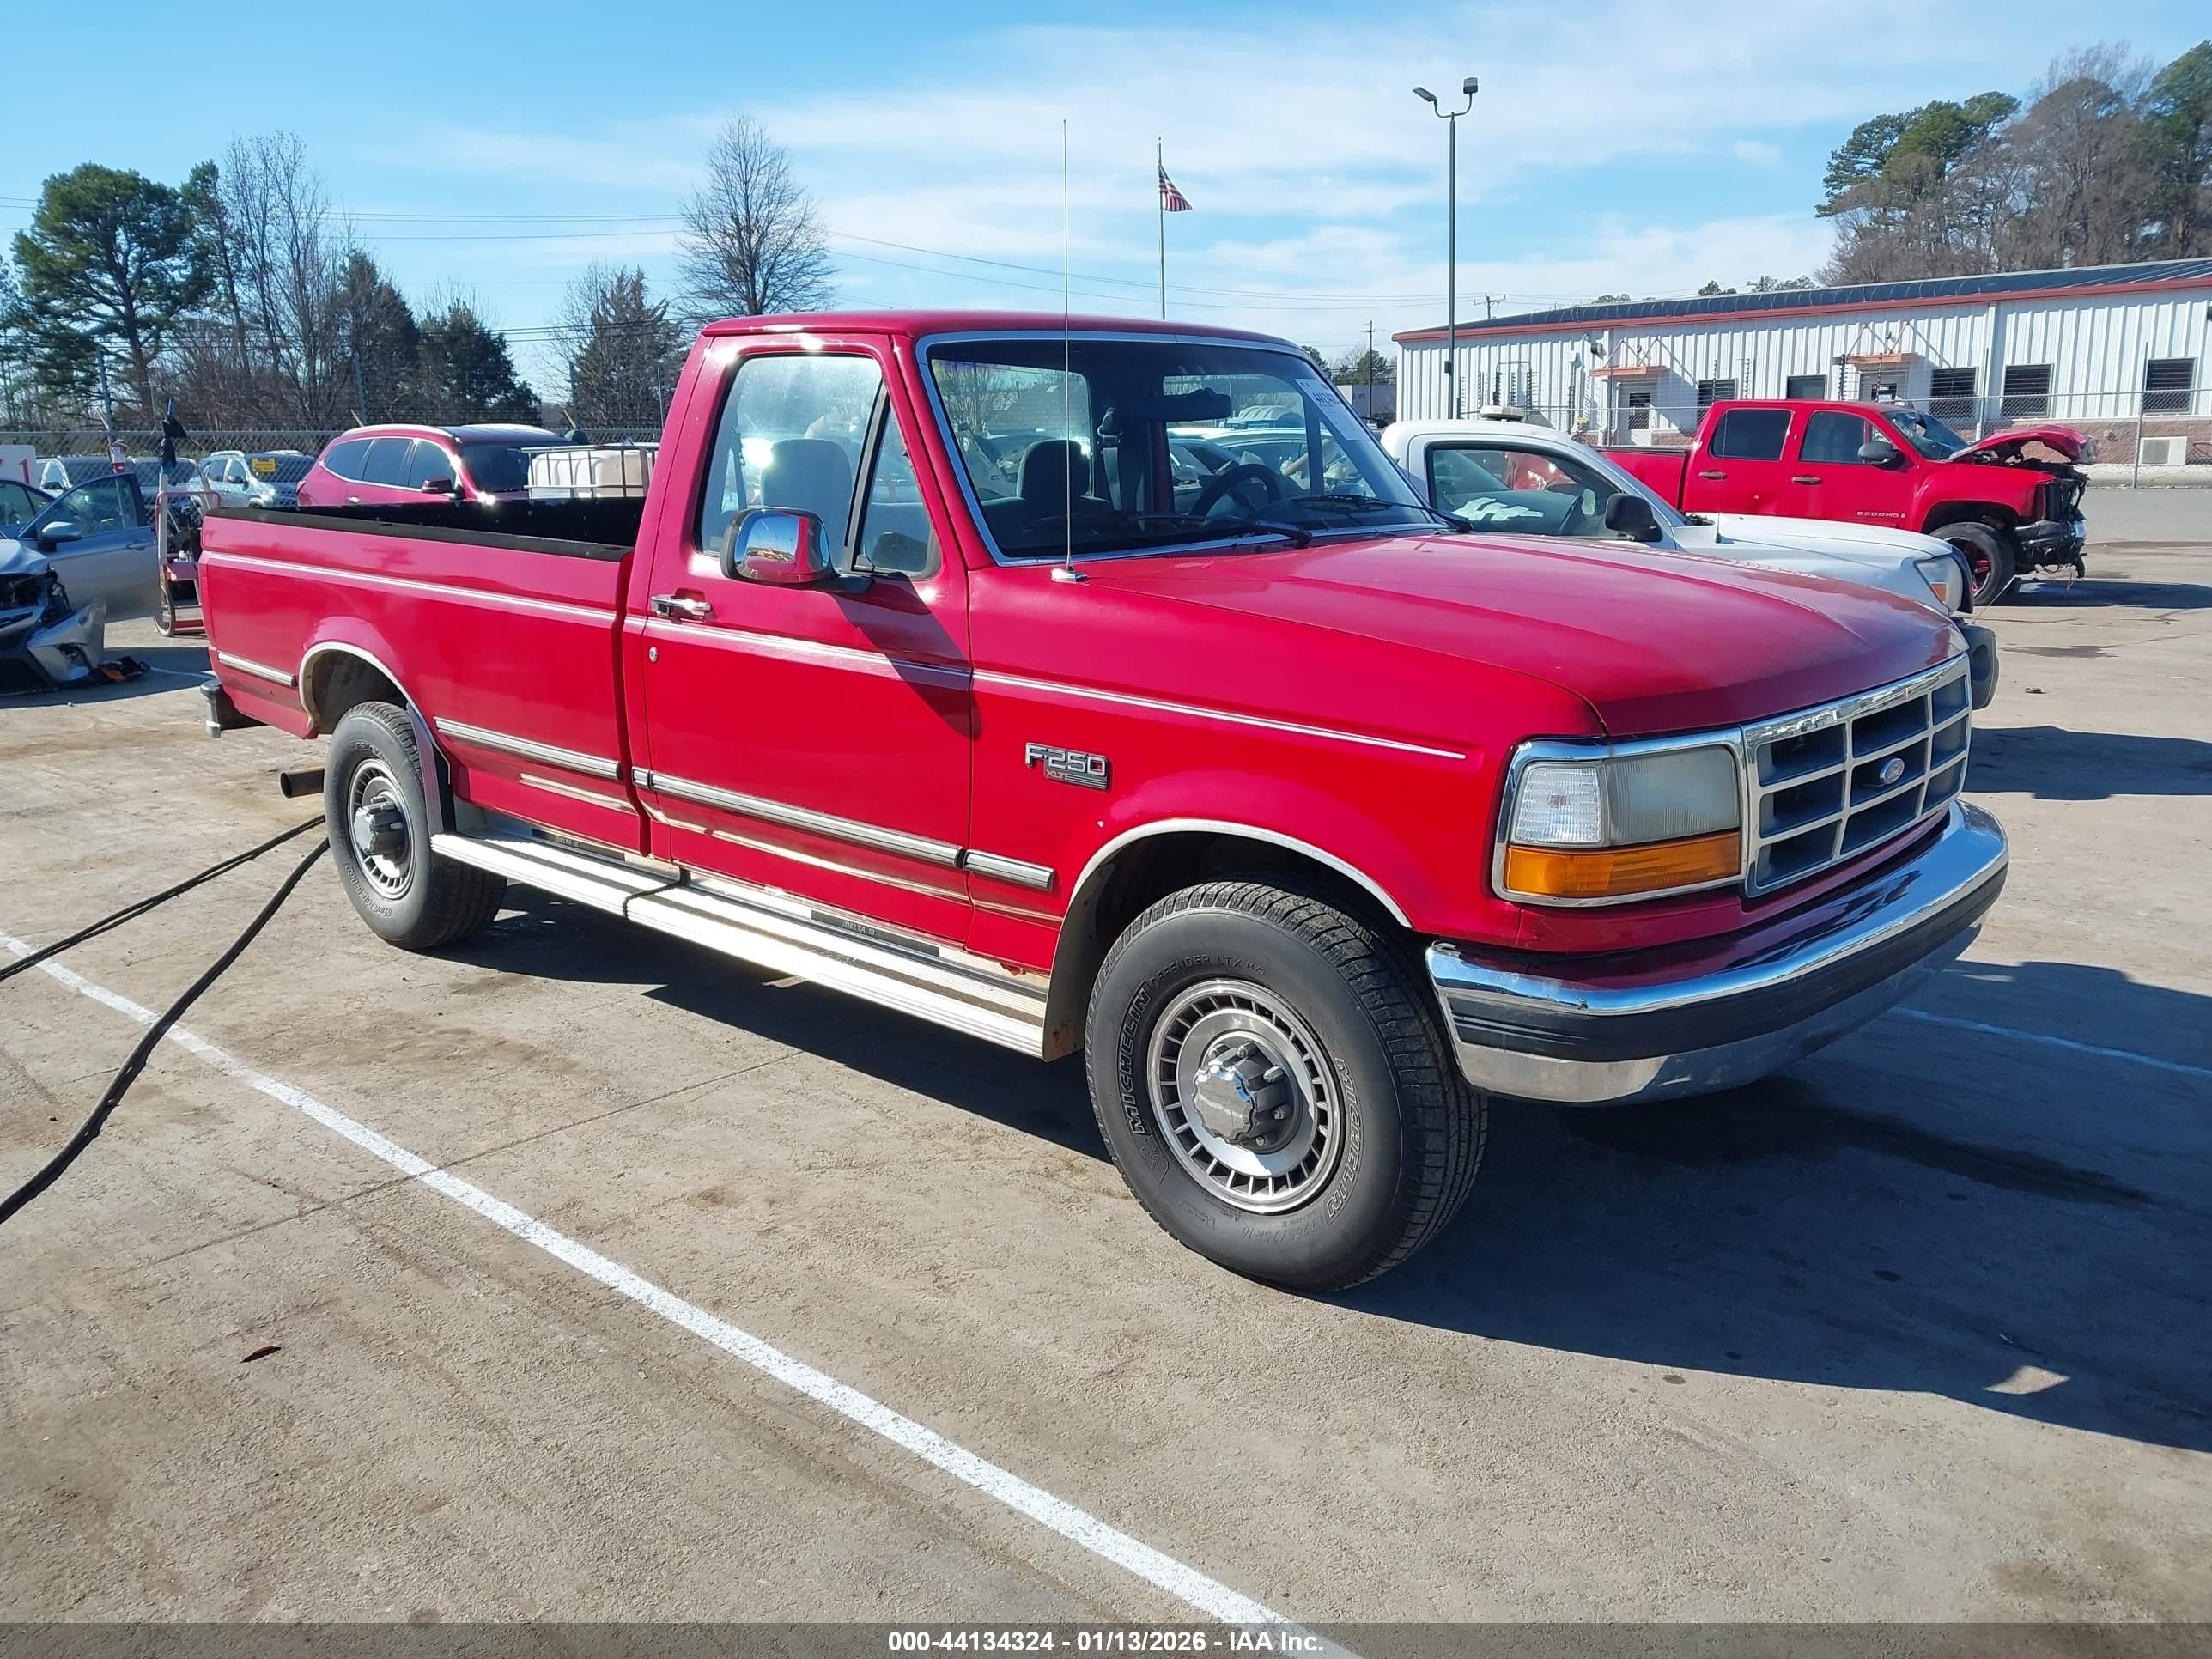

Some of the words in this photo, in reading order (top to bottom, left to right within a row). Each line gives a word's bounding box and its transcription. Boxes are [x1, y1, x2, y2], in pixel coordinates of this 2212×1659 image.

[1045, 769, 1065, 780] XLT
[345, 865, 392, 916] MICHELIN
[845, 921, 866, 933] DELTA
[1216, 954, 1243, 969] LTX
[1119, 988, 1151, 1135] MICHELIN
[1327, 1057, 1361, 1218] MICHELIN
